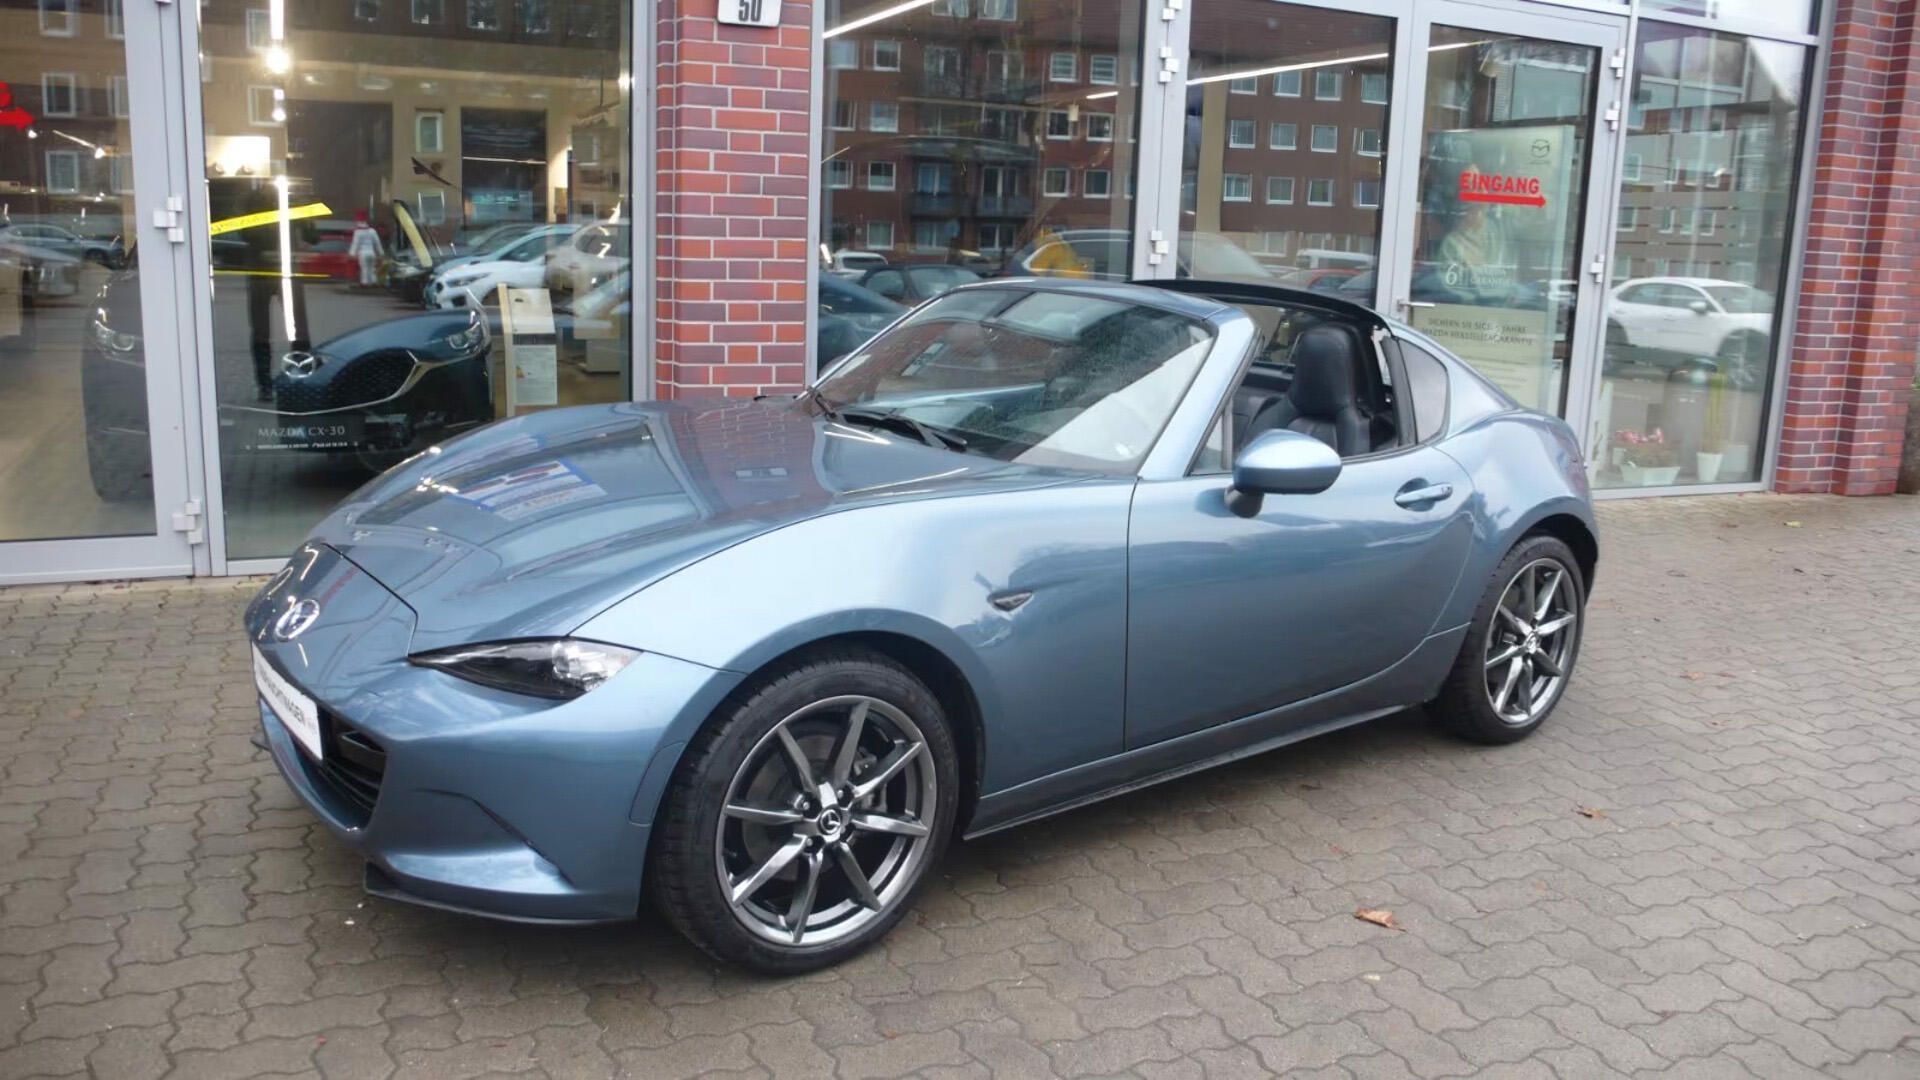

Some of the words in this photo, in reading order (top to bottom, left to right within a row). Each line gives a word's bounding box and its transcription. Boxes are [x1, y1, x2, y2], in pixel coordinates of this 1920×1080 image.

[738, 0, 763, 22] 50
[1460, 171, 1540, 195] EINGANG
[258, 427, 305, 438] MAZDA
[308, 425, 346, 437] CX-30
